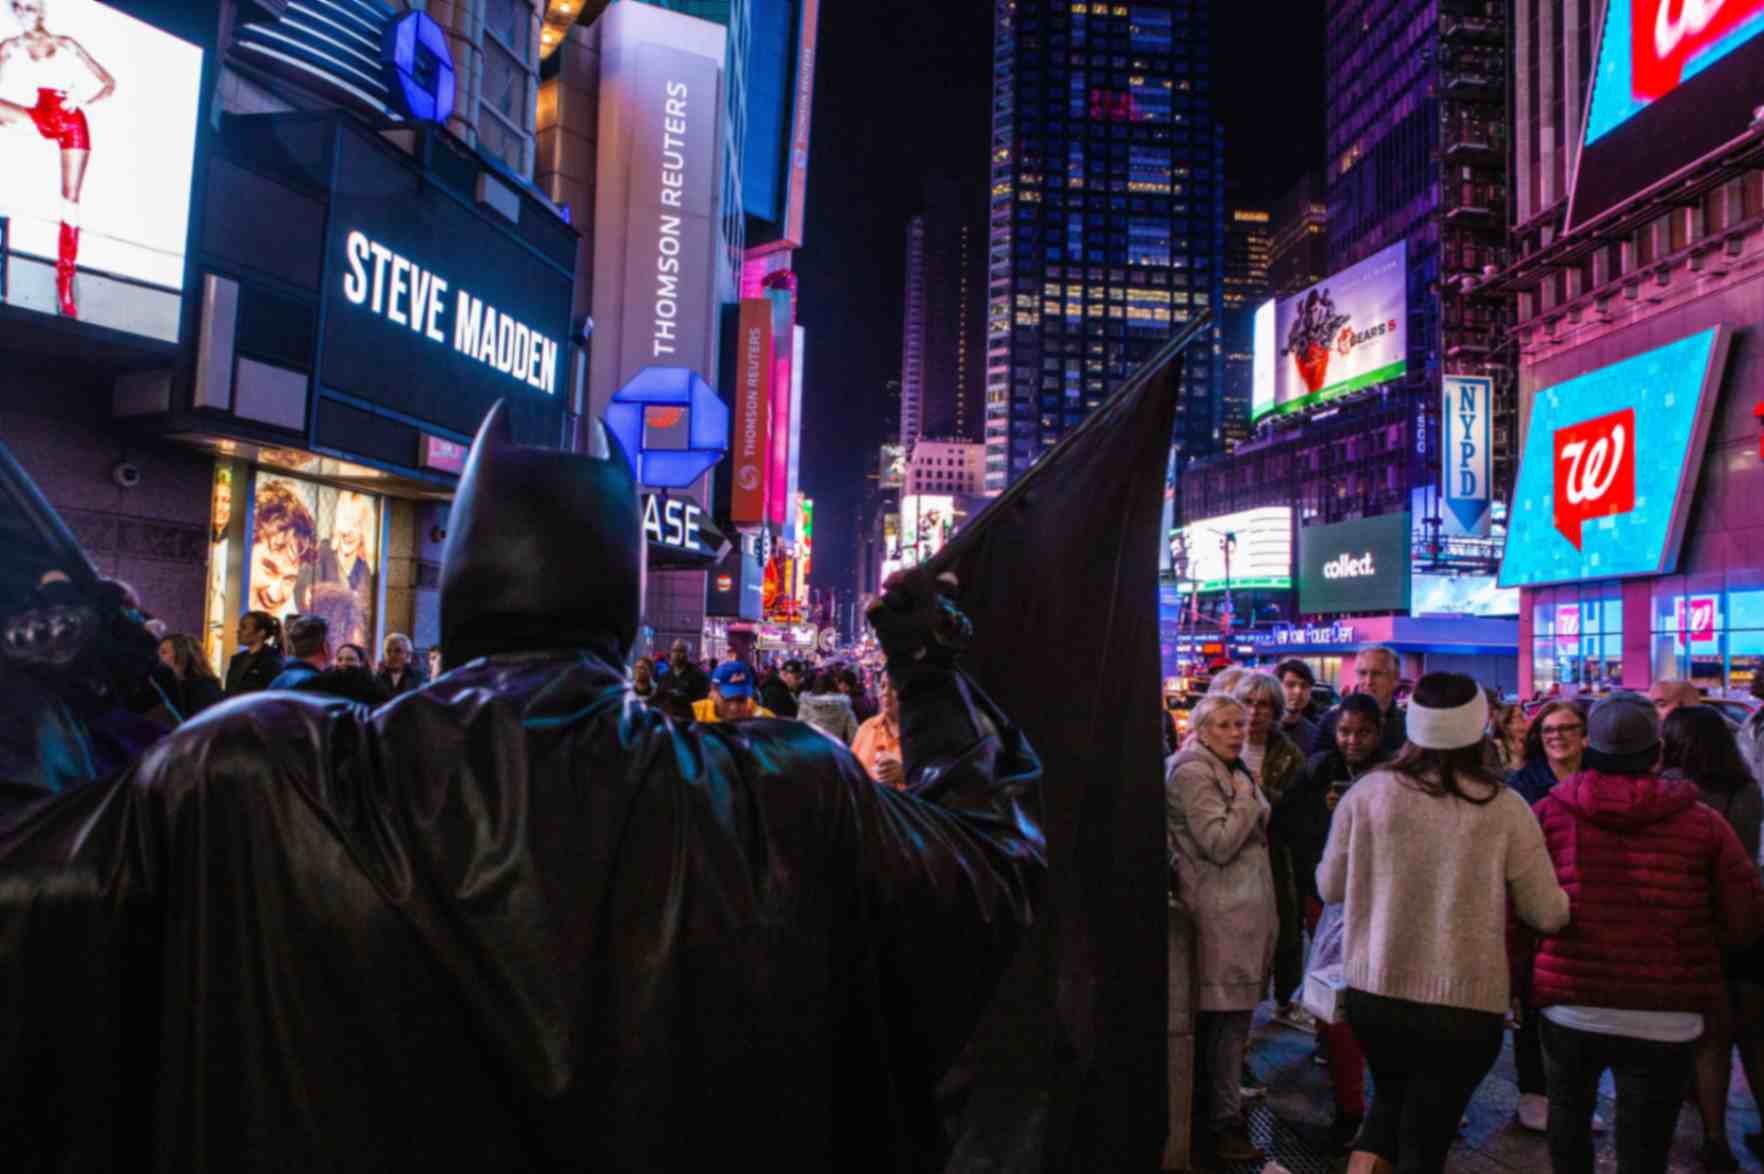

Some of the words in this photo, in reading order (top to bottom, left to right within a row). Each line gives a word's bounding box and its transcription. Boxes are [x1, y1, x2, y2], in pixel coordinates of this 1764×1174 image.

[660, 80, 688, 207] REUTERS
[344, 230, 448, 343] STEVE
[454, 288, 557, 395] MADDEN
[654, 214, 681, 357] THOMSON
[747, 327, 761, 388] REUTERS
[744, 391, 759, 457] THOMSON
[1459, 385, 1477, 497] NYPD
[1560, 424, 1625, 505] W
